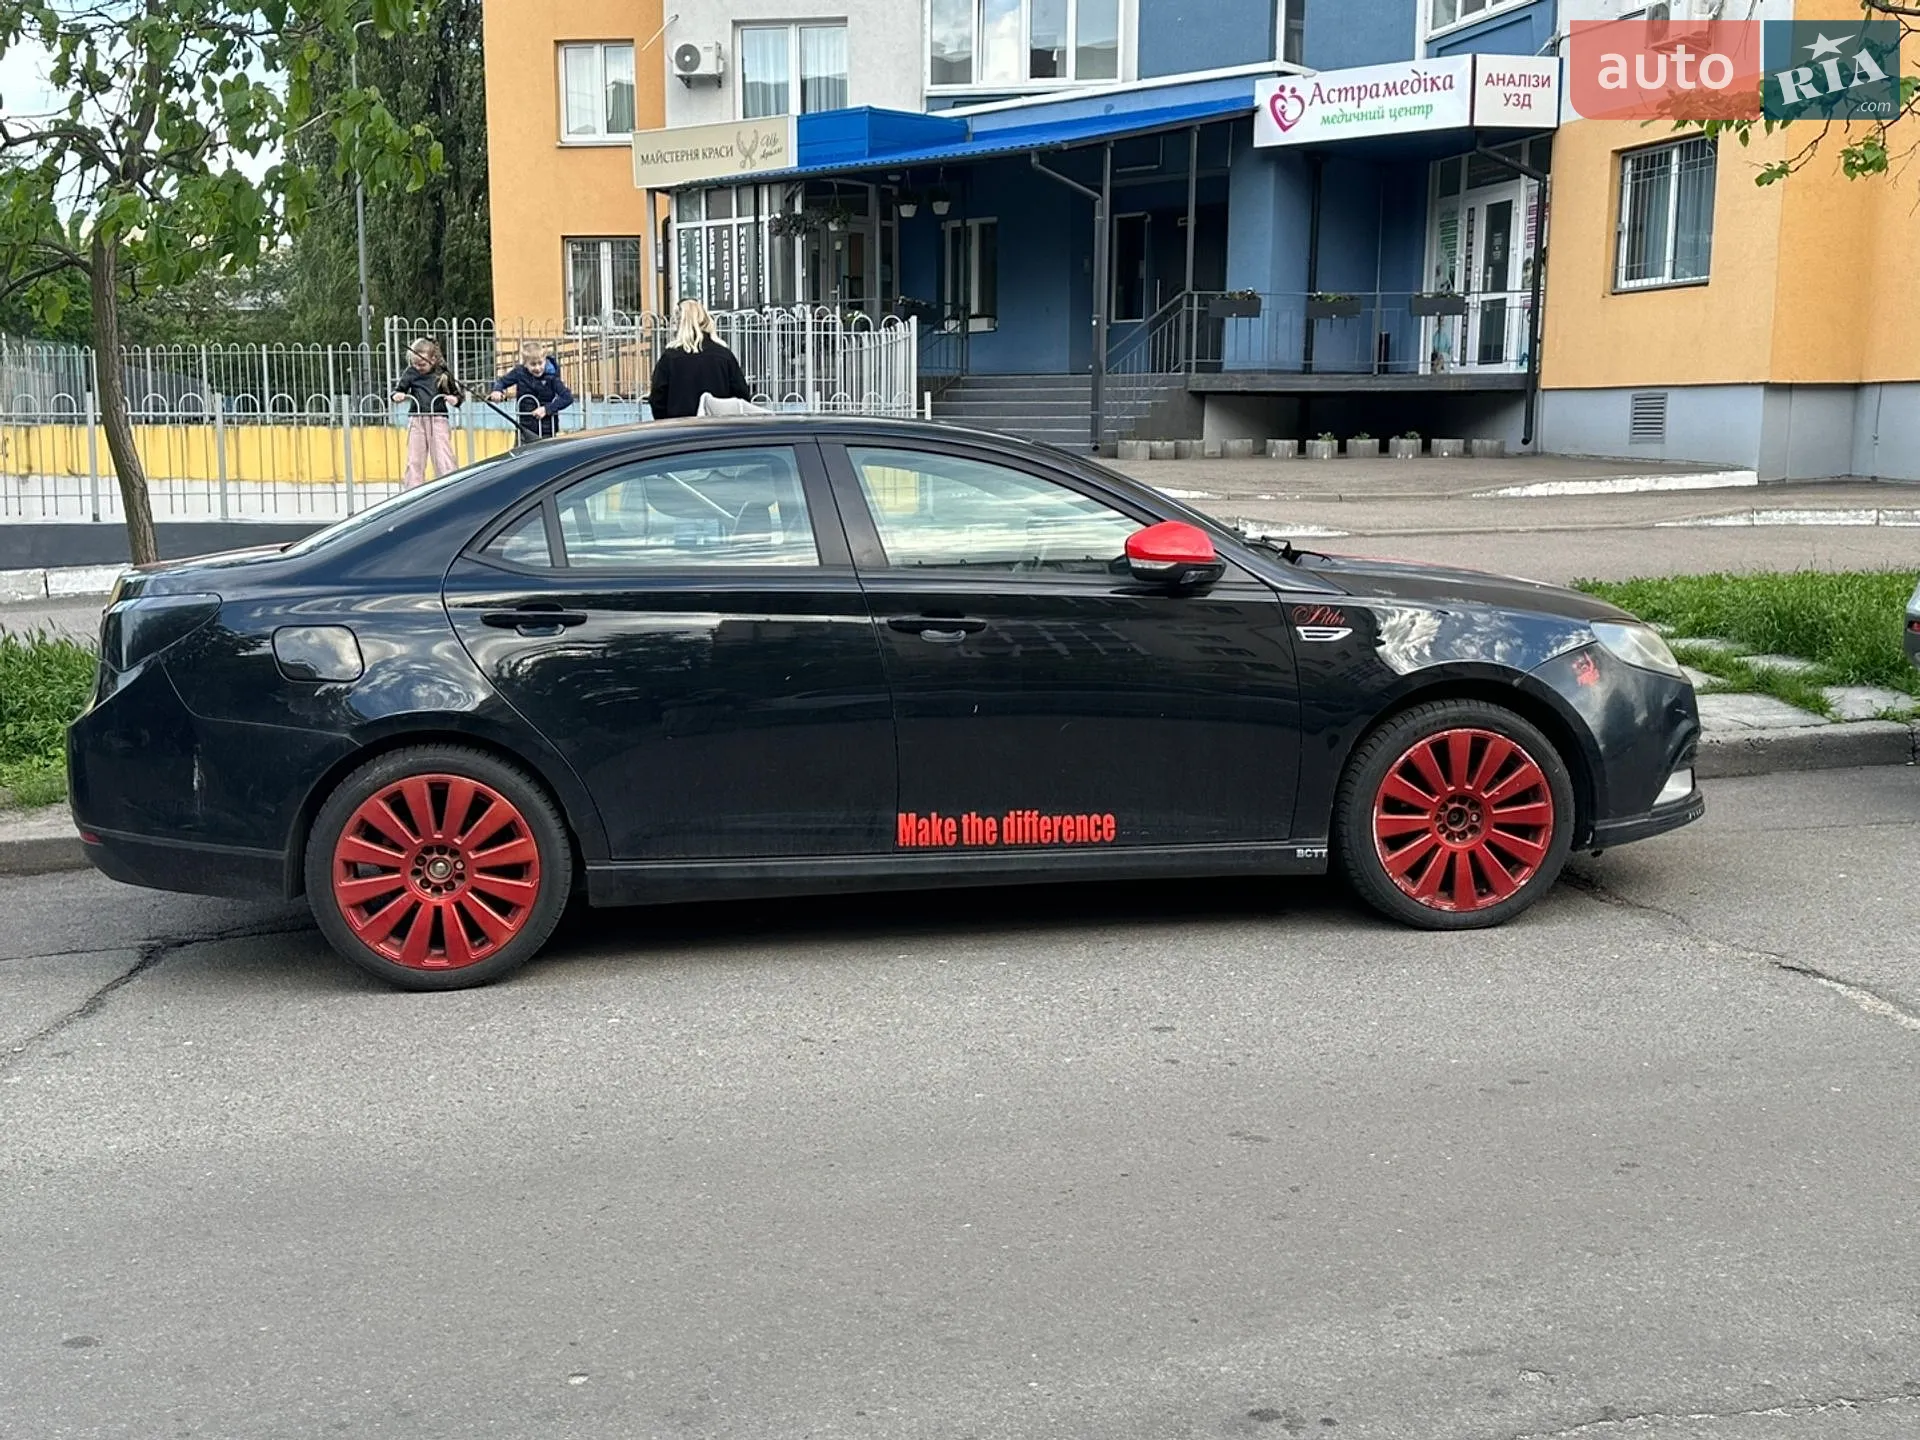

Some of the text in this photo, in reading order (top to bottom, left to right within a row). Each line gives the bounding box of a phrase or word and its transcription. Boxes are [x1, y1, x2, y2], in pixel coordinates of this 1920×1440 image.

[1308, 69, 1456, 107] Астрамедіка
[1484, 73, 1552, 89] АНАЛІЗИ
[1319, 103, 1434, 127] медичний центр
[1503, 93, 1532, 110] УЗД
[640, 145, 734, 166] МАЙСТЕРНЯ КРАСИ
[722, 229, 731, 302] ПОДОЛОГ
[739, 226, 749, 296] МАНІКЮР
[897, 810, 1116, 847] Make the difference
